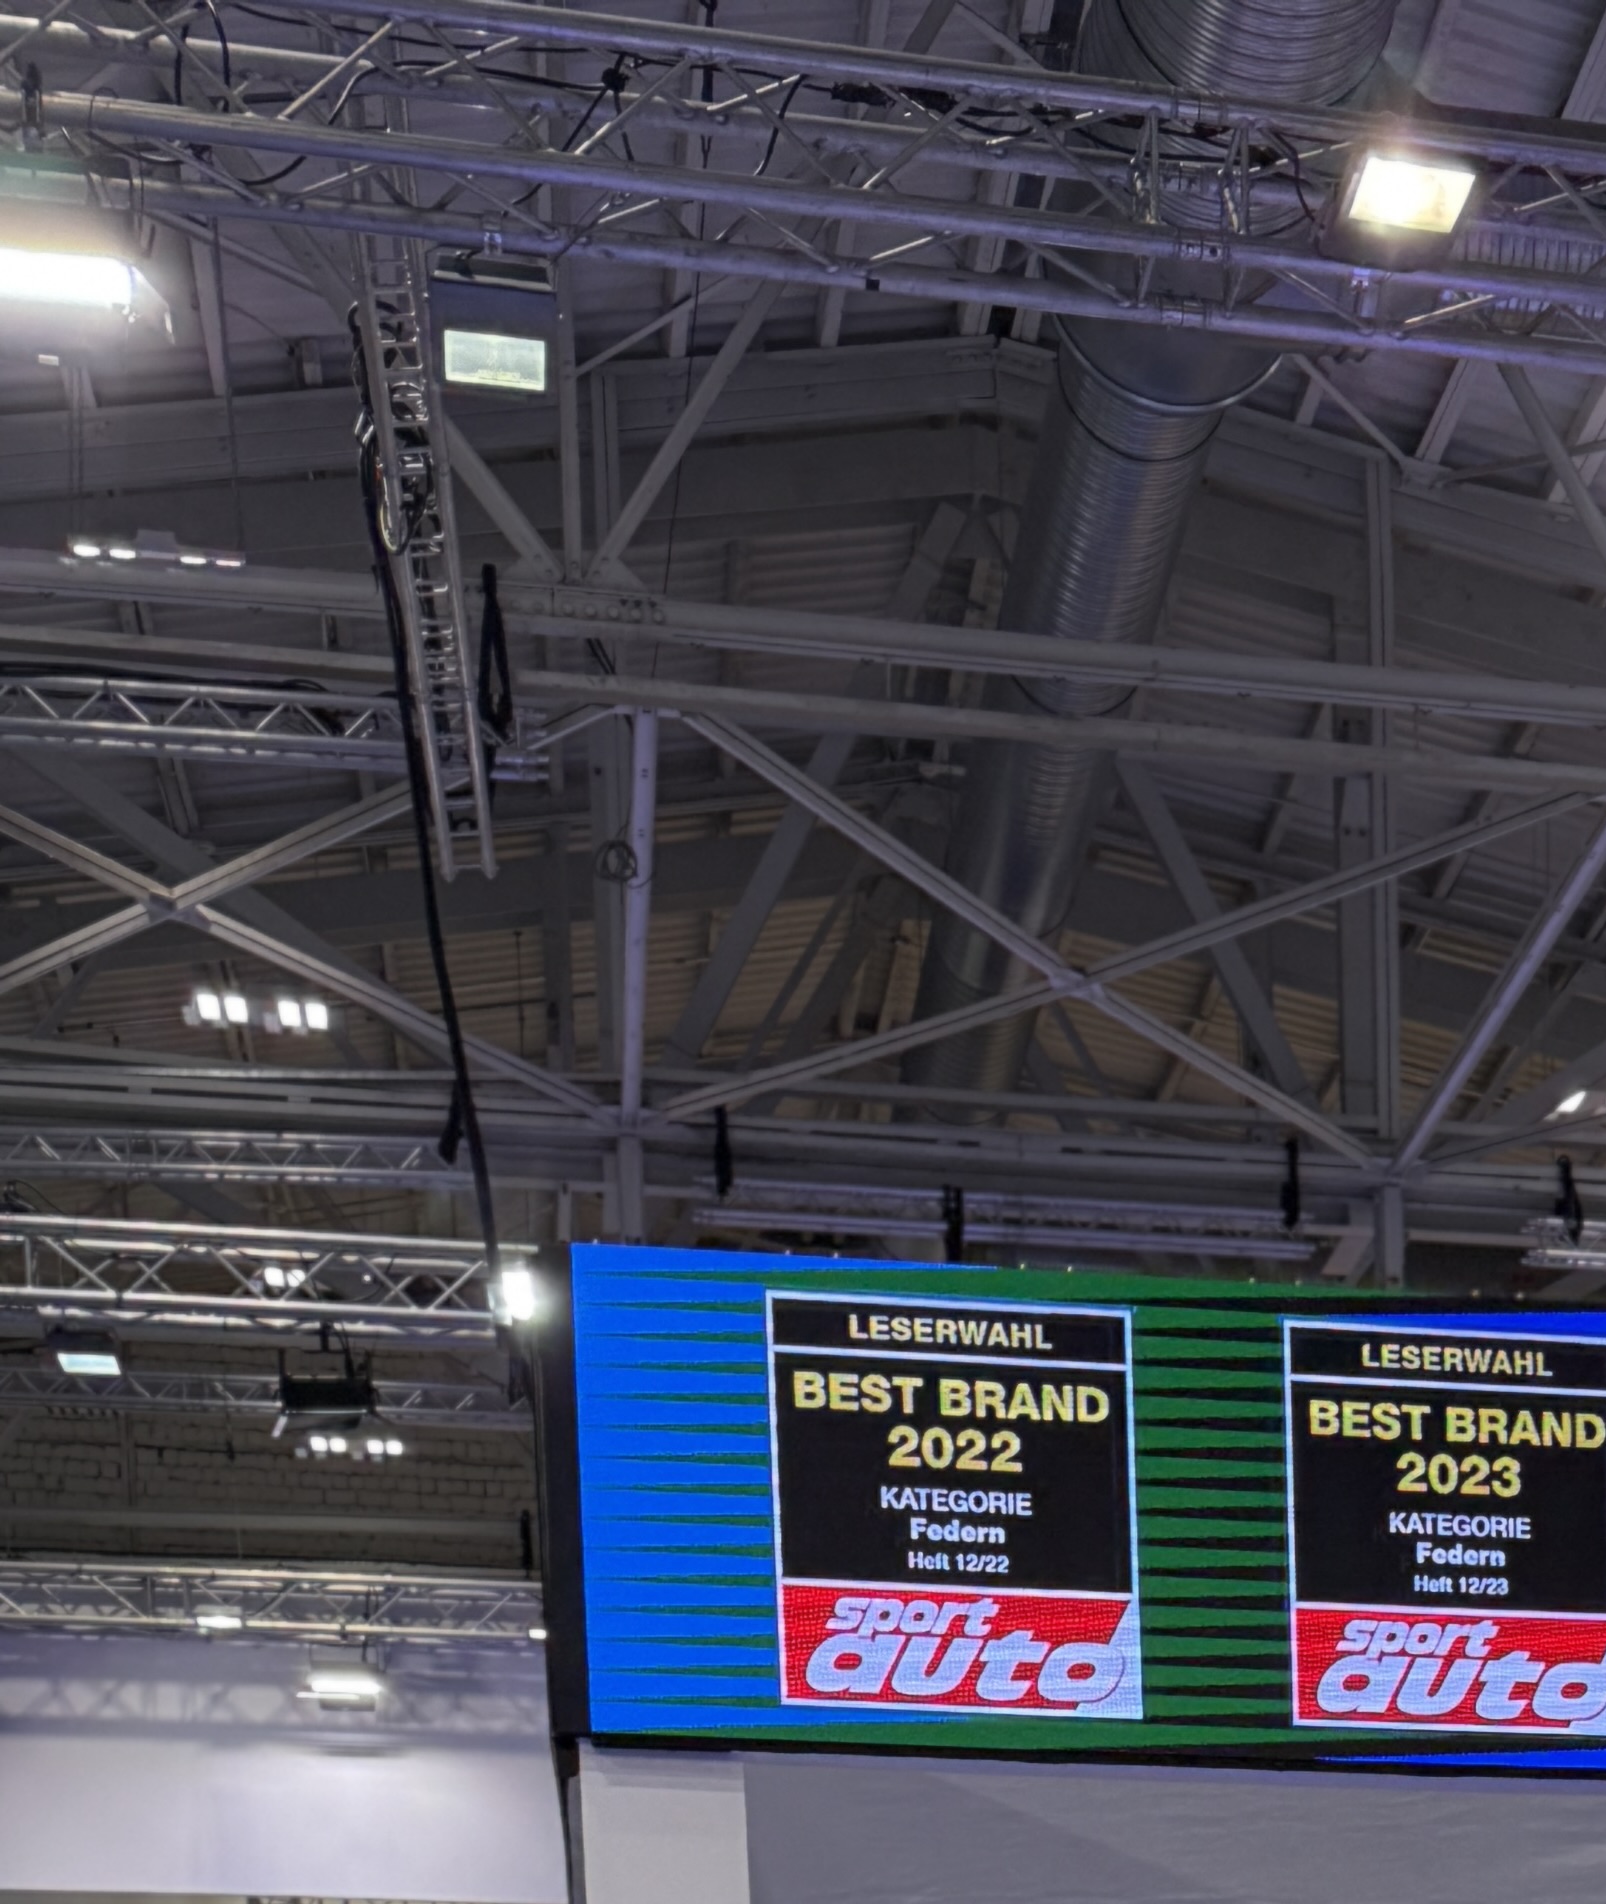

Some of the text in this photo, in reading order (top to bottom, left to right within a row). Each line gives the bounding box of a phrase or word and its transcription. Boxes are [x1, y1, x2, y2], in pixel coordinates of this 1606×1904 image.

[849, 1314, 1053, 1350] LESERWAHL
[1361, 1343, 1553, 1376] LESERWAHL
[793, 1371, 1109, 1422] BEST BRAND
[1309, 1400, 1606, 1448] BEST BRAND
[888, 1425, 1023, 1472] 2022
[1397, 1452, 1521, 1497] 2023
[880, 1486, 1033, 1516] KATEGORIE
[910, 1517, 1005, 1543] Federn
[1389, 1512, 1531, 1539] KATEGORIE
[908, 1551, 1009, 1574] Heft 12/22
[1416, 1542, 1506, 1566] Federn
[1414, 1575, 1509, 1595] Heft 12/23
[825, 1596, 1000, 1640] sport
[1335, 1619, 1499, 1660] sport
[806, 1630, 1126, 1702] auto
